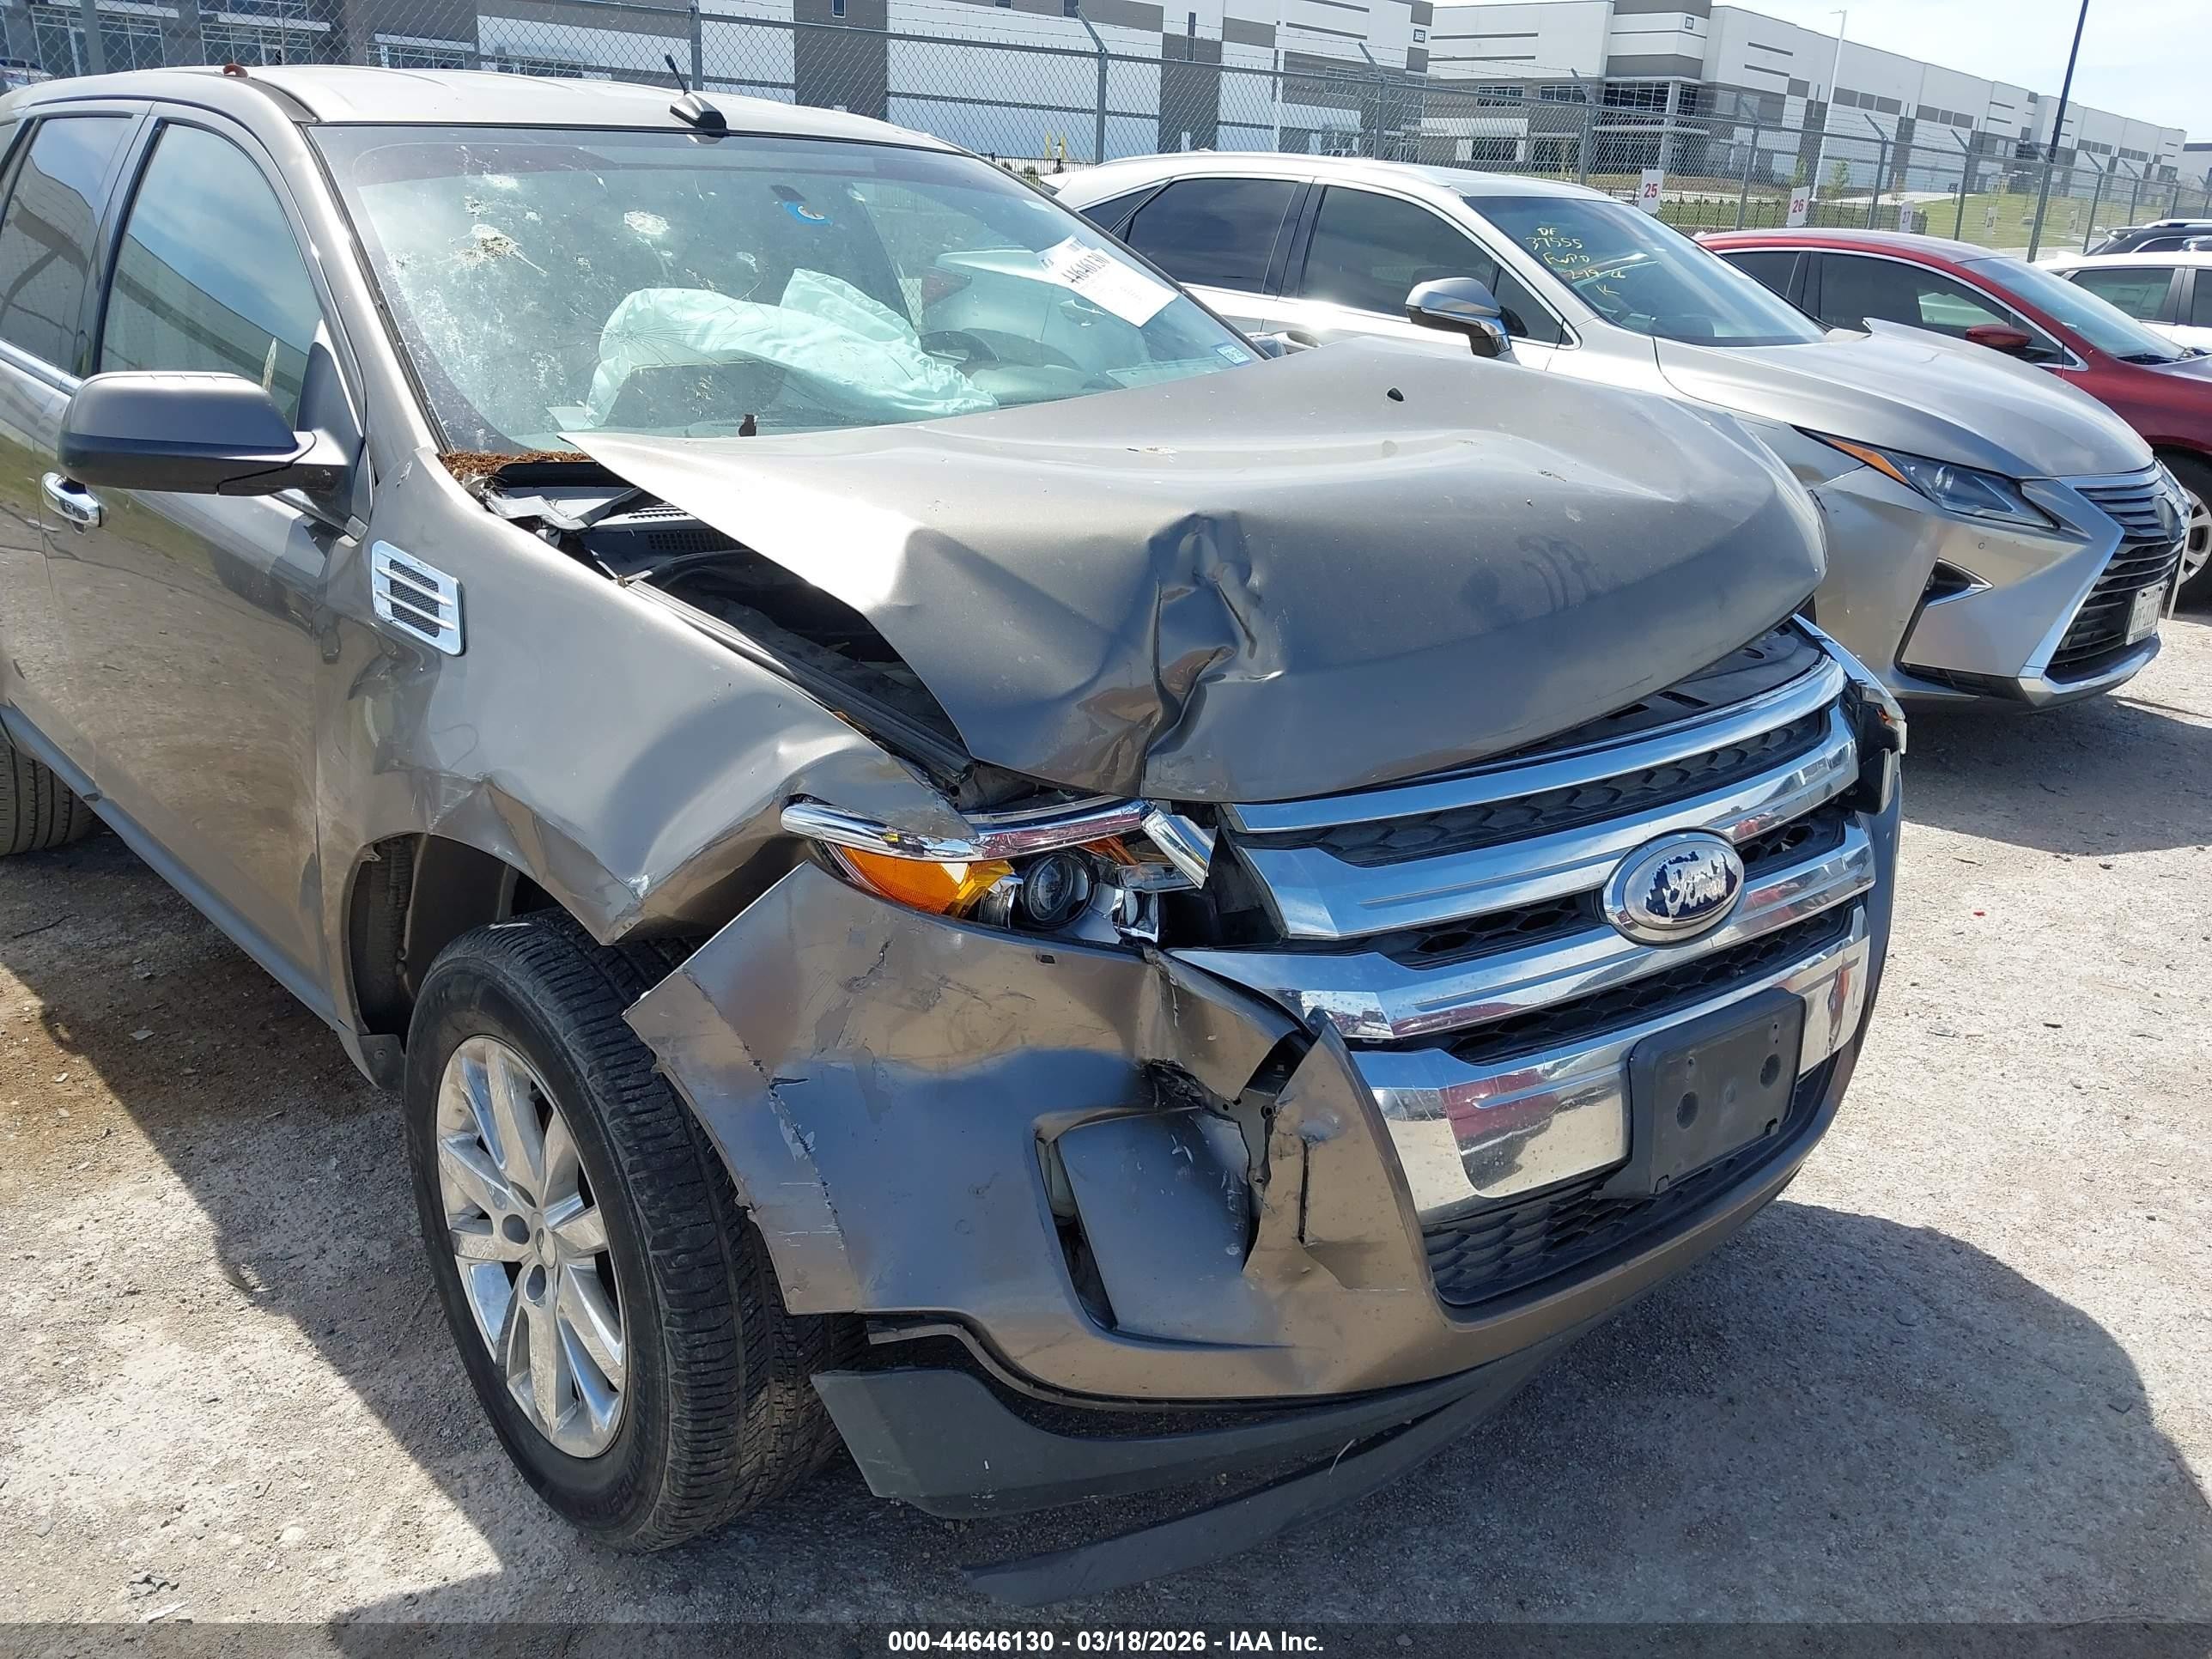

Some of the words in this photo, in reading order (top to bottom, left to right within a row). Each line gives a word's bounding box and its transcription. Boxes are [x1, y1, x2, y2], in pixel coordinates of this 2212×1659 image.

[1644, 183, 1658, 198] 25
[1792, 198, 1804, 213] 26
[1061, 252, 1111, 284] 44646130
